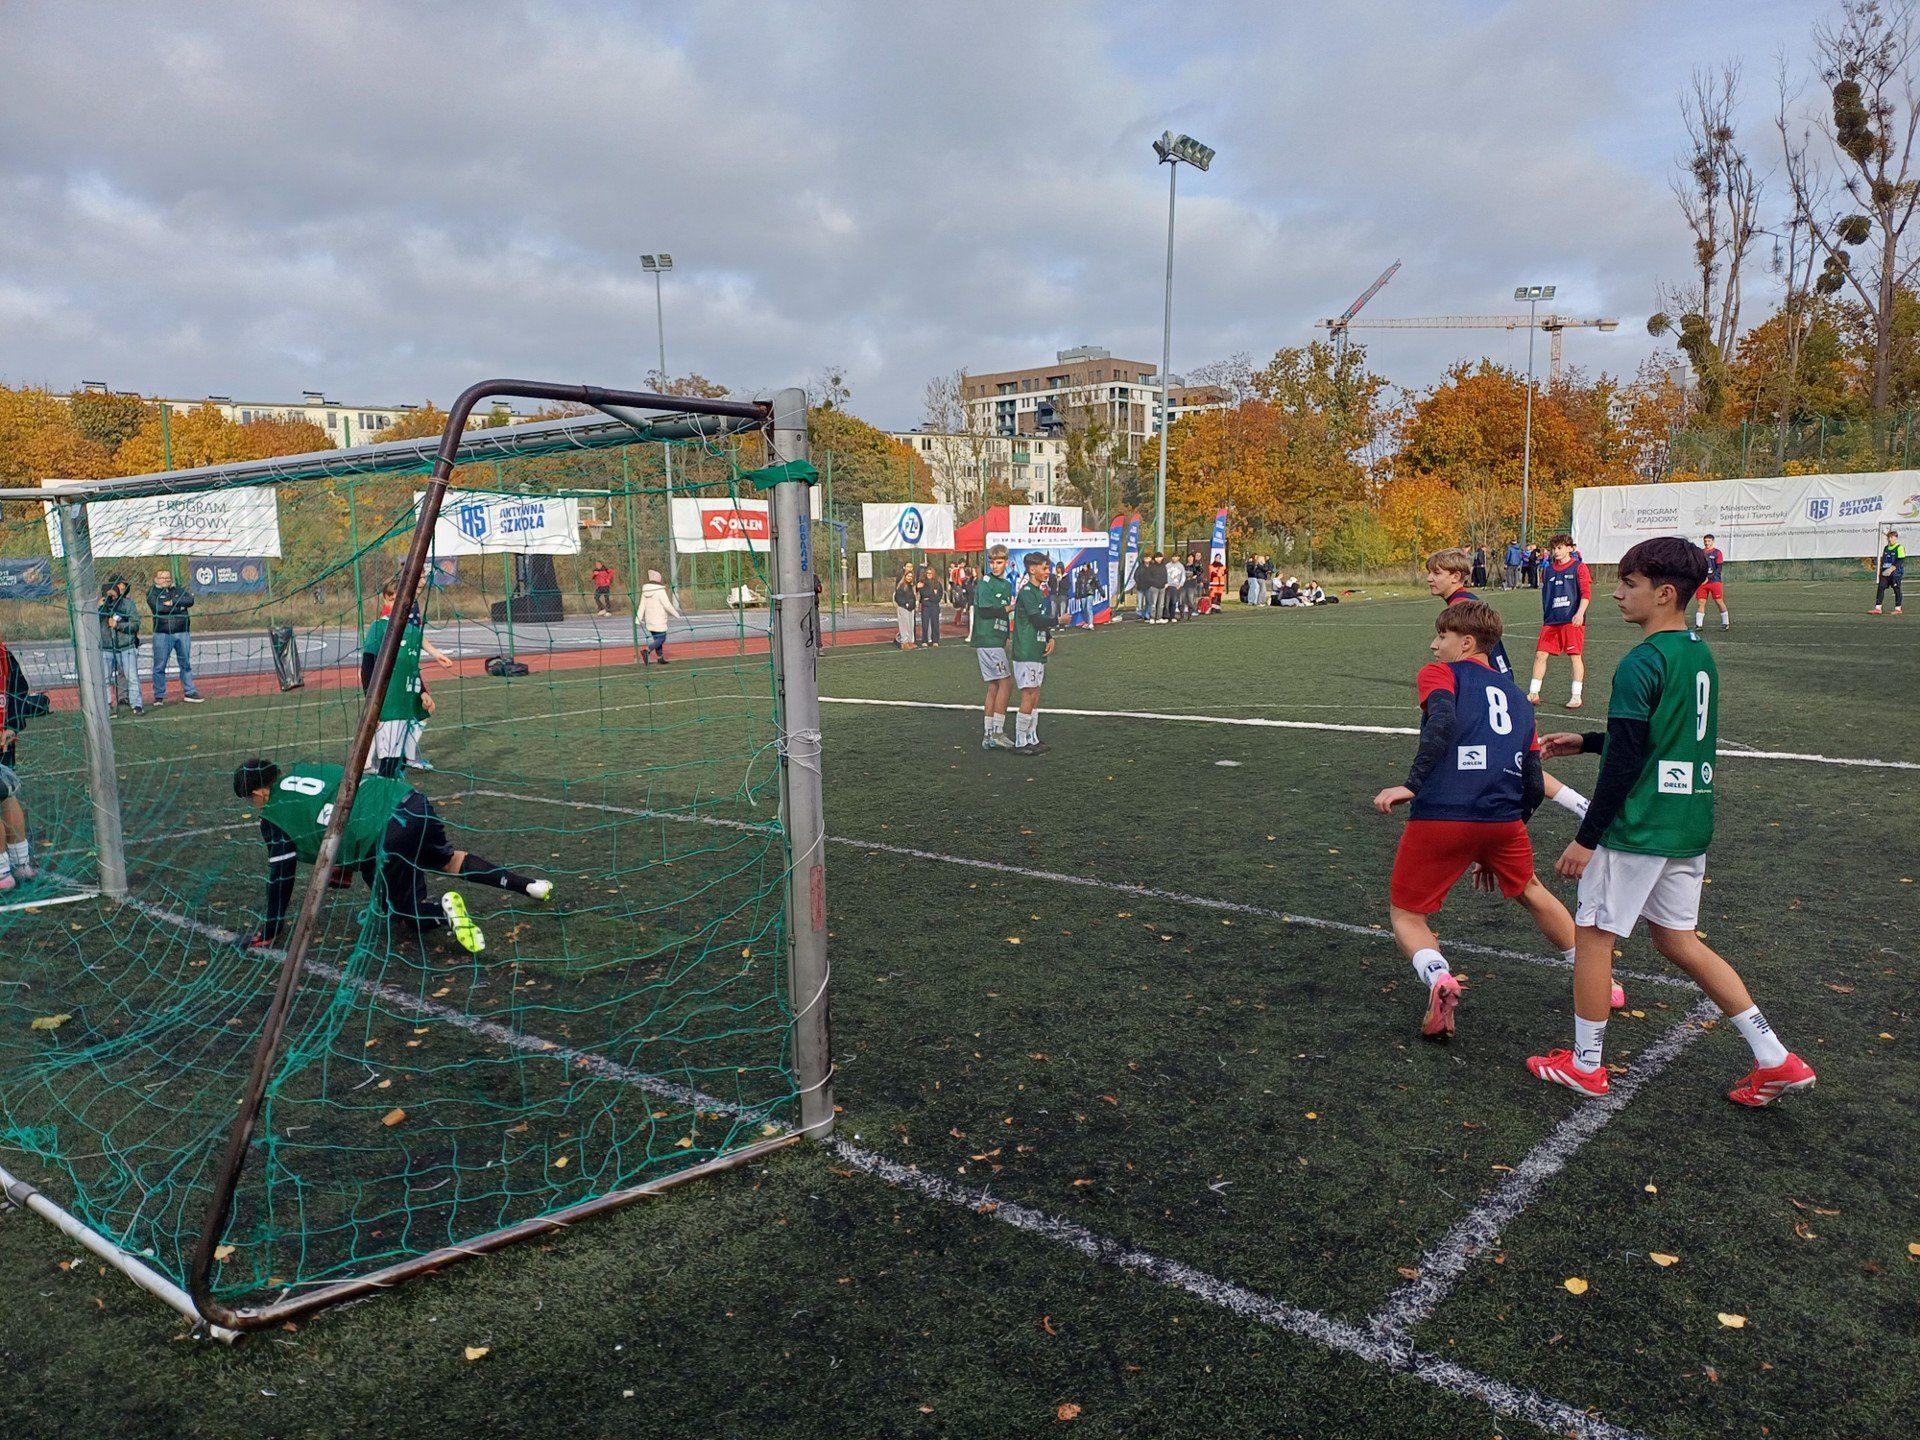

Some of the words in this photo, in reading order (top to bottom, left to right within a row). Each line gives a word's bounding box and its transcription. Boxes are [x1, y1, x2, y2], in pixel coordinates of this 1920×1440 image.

[157, 500, 228, 513] PROGRAM
[1720, 504, 1771, 512] Ministerstwo
[1839, 494, 1884, 509] AKTYWNA
[500, 503, 545, 518] AKTYWNA
[1637, 508, 1678, 516] PROGRAM
[1720, 512, 1746, 521] Sportu
[1752, 510, 1788, 520] Turystyki
[1810, 499, 1829, 520] AS
[1838, 502, 1883, 517] SZKOŁA
[159, 516, 229, 530] RZĄDOWY
[500, 515, 545, 534] SZKOŁA
[728, 518, 763, 531] ORLEN
[904, 516, 919, 534] PZU
[1636, 515, 1679, 524] RZĄDOWY
[1030, 669, 1036, 682] 3
[1485, 685, 1513, 735] 8
[1695, 670, 1711, 742] 9
[279, 775, 325, 796] 8
[1663, 781, 1688, 789] ORLEN
